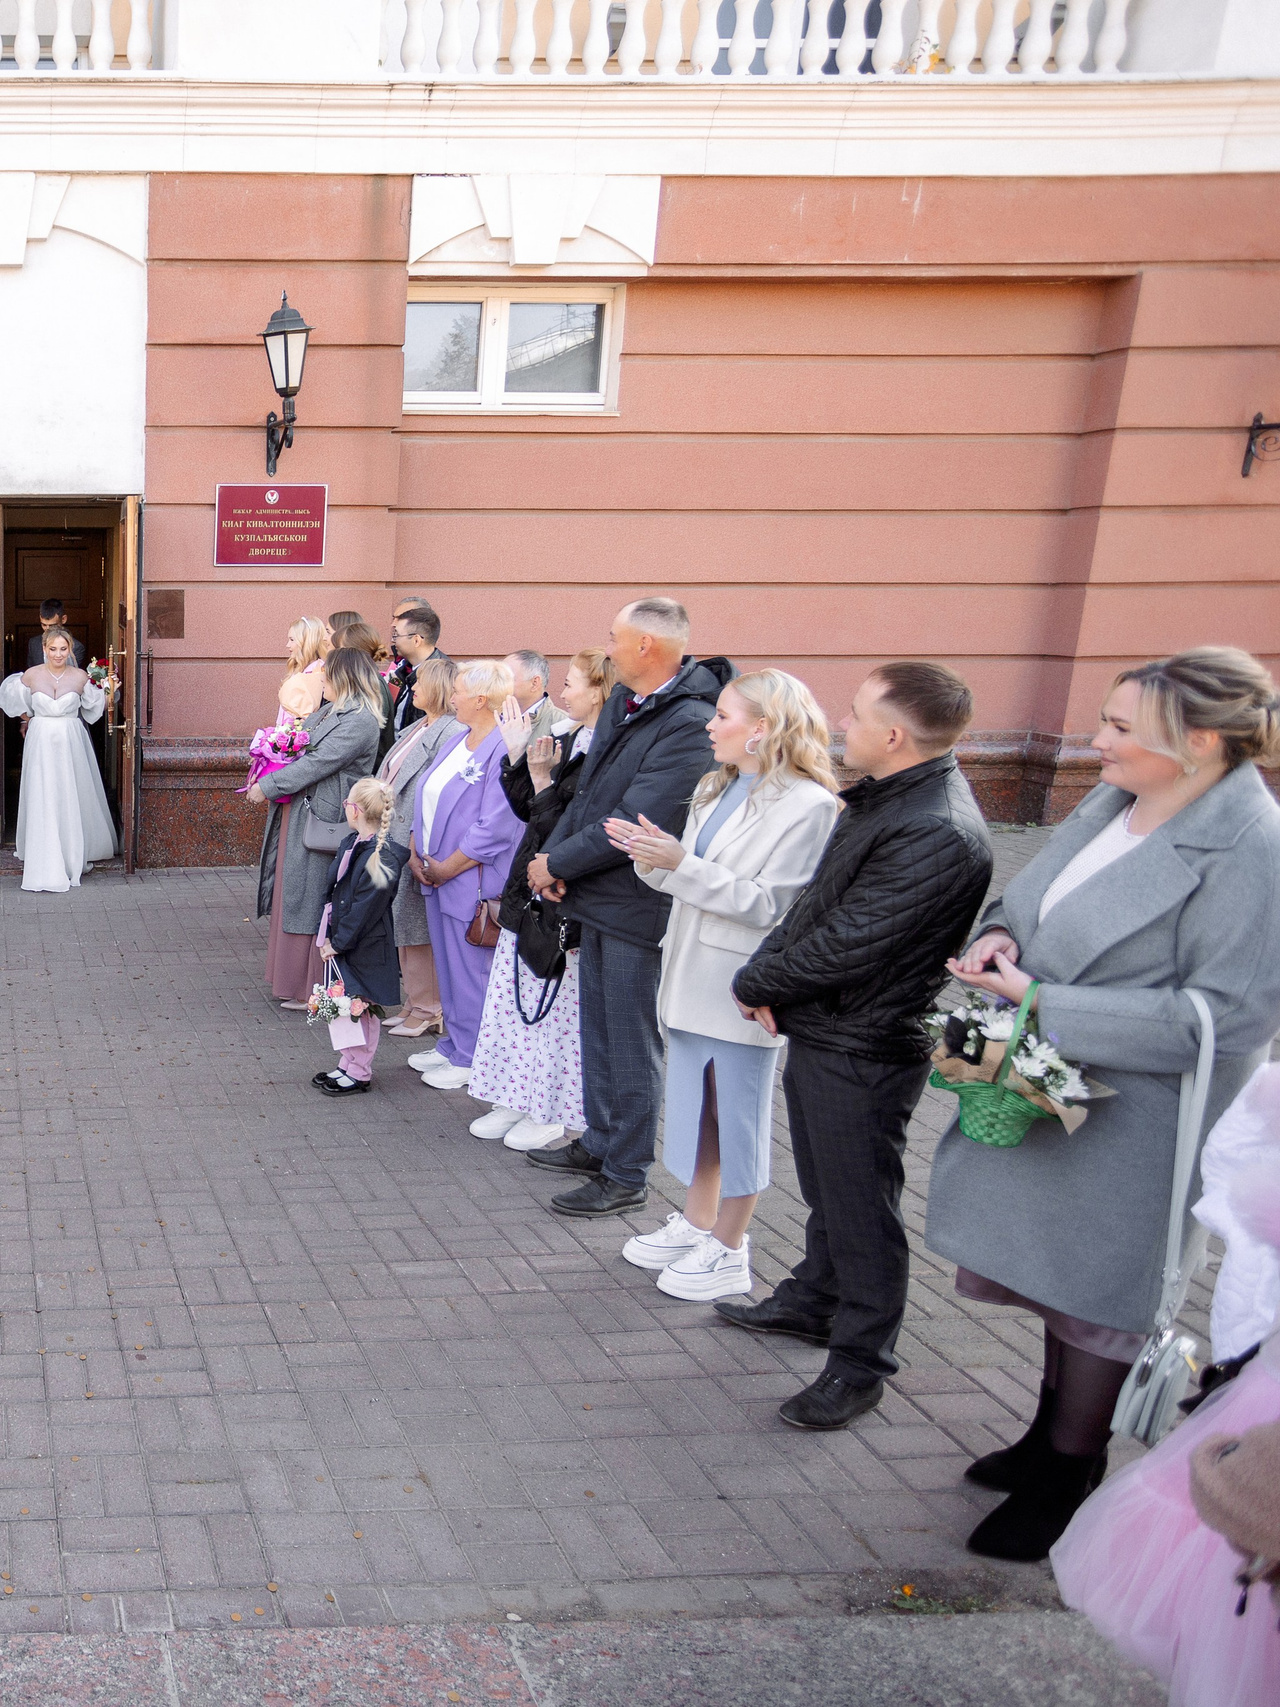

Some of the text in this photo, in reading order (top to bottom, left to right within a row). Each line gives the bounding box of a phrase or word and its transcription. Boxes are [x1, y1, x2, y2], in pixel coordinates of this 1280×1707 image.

[222, 520, 320, 528] КИАГ КИВАЛТОННИЛЭН
[234, 534, 307, 542] КУЗПАЛЪЯСЬКОН
